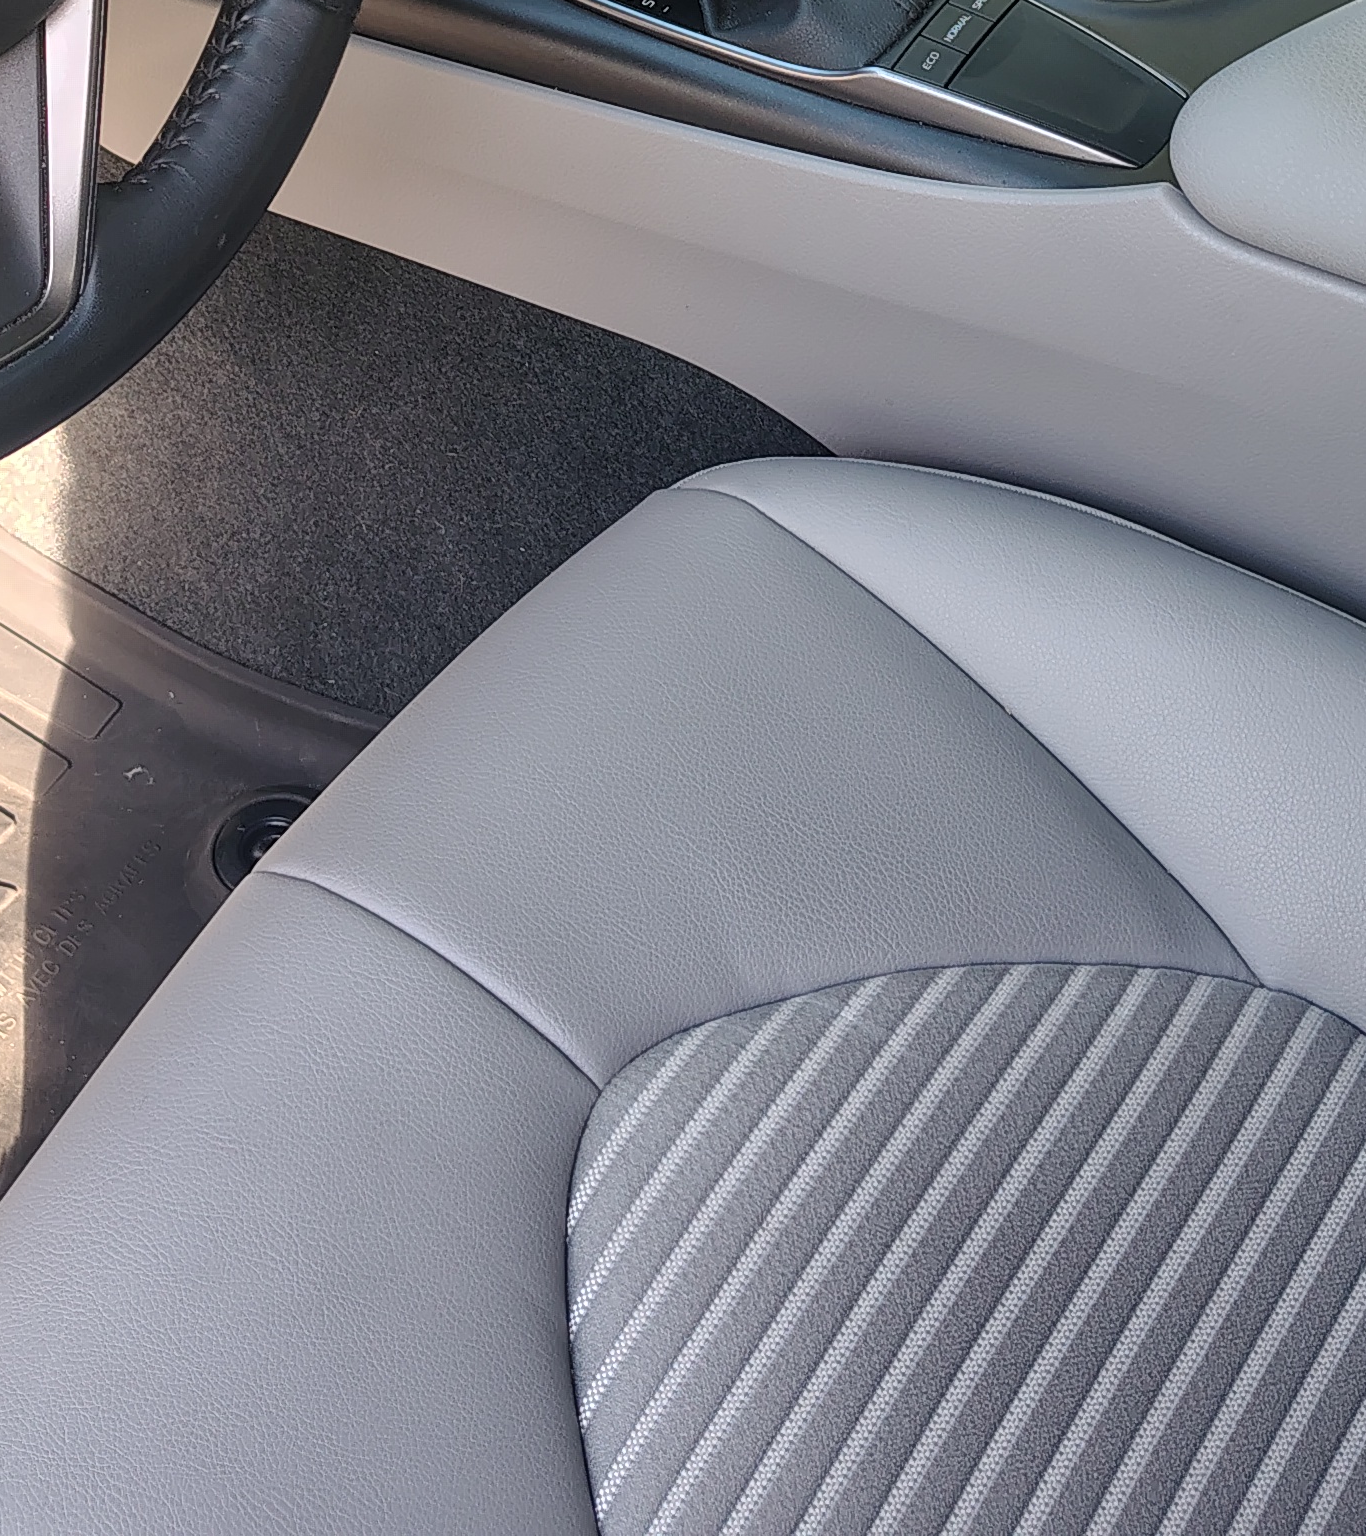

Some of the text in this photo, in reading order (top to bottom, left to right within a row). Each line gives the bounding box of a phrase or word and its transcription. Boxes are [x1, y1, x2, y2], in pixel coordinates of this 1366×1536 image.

[943, 14, 973, 43] NORMAL
[922, 51, 940, 71] ECO
[16, 959, 61, 1009] AVEC
